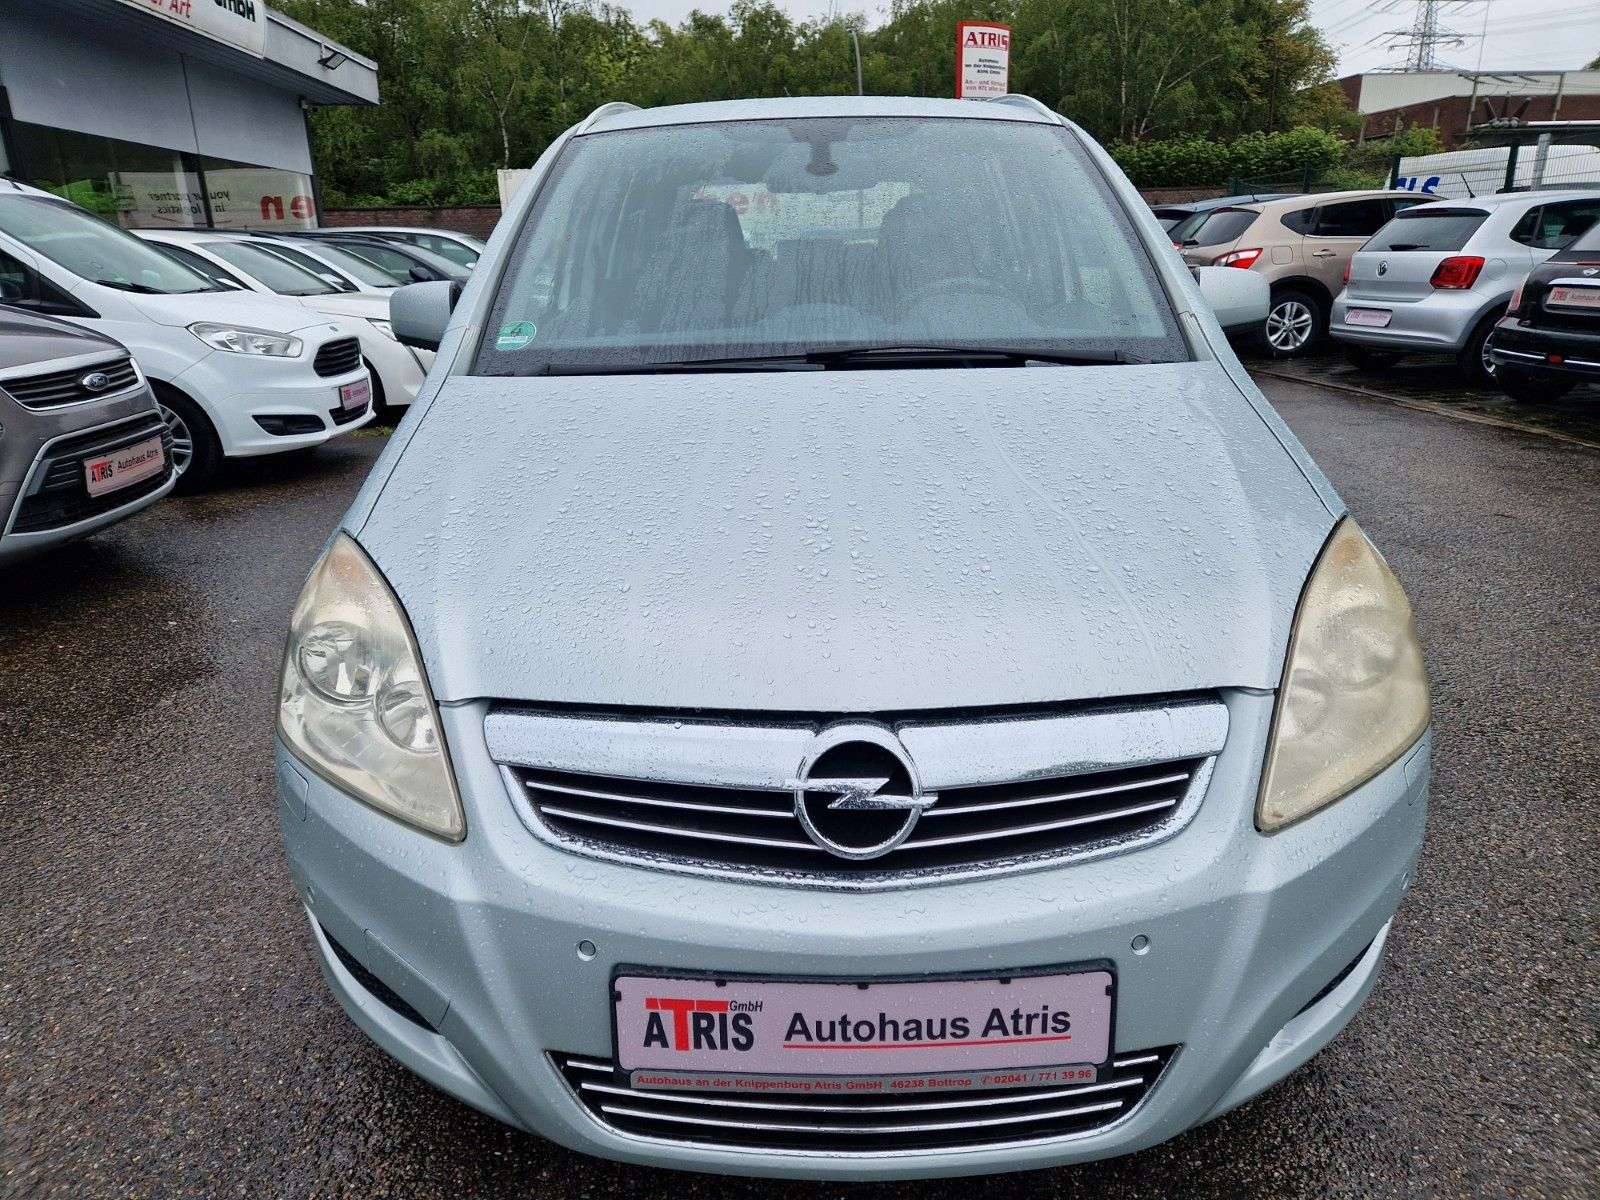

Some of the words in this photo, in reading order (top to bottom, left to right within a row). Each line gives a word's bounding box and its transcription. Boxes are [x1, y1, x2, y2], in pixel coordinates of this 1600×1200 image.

[91, 459, 114, 483] ATRIS
[117, 454, 146, 469] Autohaus
[729, 1000, 763, 1013] GmbH
[643, 997, 755, 1052] ATRIS
[784, 1011, 970, 1042] Autohaus
[981, 1005, 1071, 1038] Atris
[637, 1075, 692, 1087] Autohaus
[695, 1078, 710, 1087] an
[712, 1077, 732, 1088] der
[735, 1078, 811, 1091] Knippenburg
[814, 1079, 842, 1090] Atris
[846, 1080, 882, 1091] GmbH
[890, 1079, 925, 1089] 46238
[928, 1077, 972, 1090] Bottrop
[994, 1073, 1028, 1084] 02041
[1038, 1071, 1057, 1082] 771
